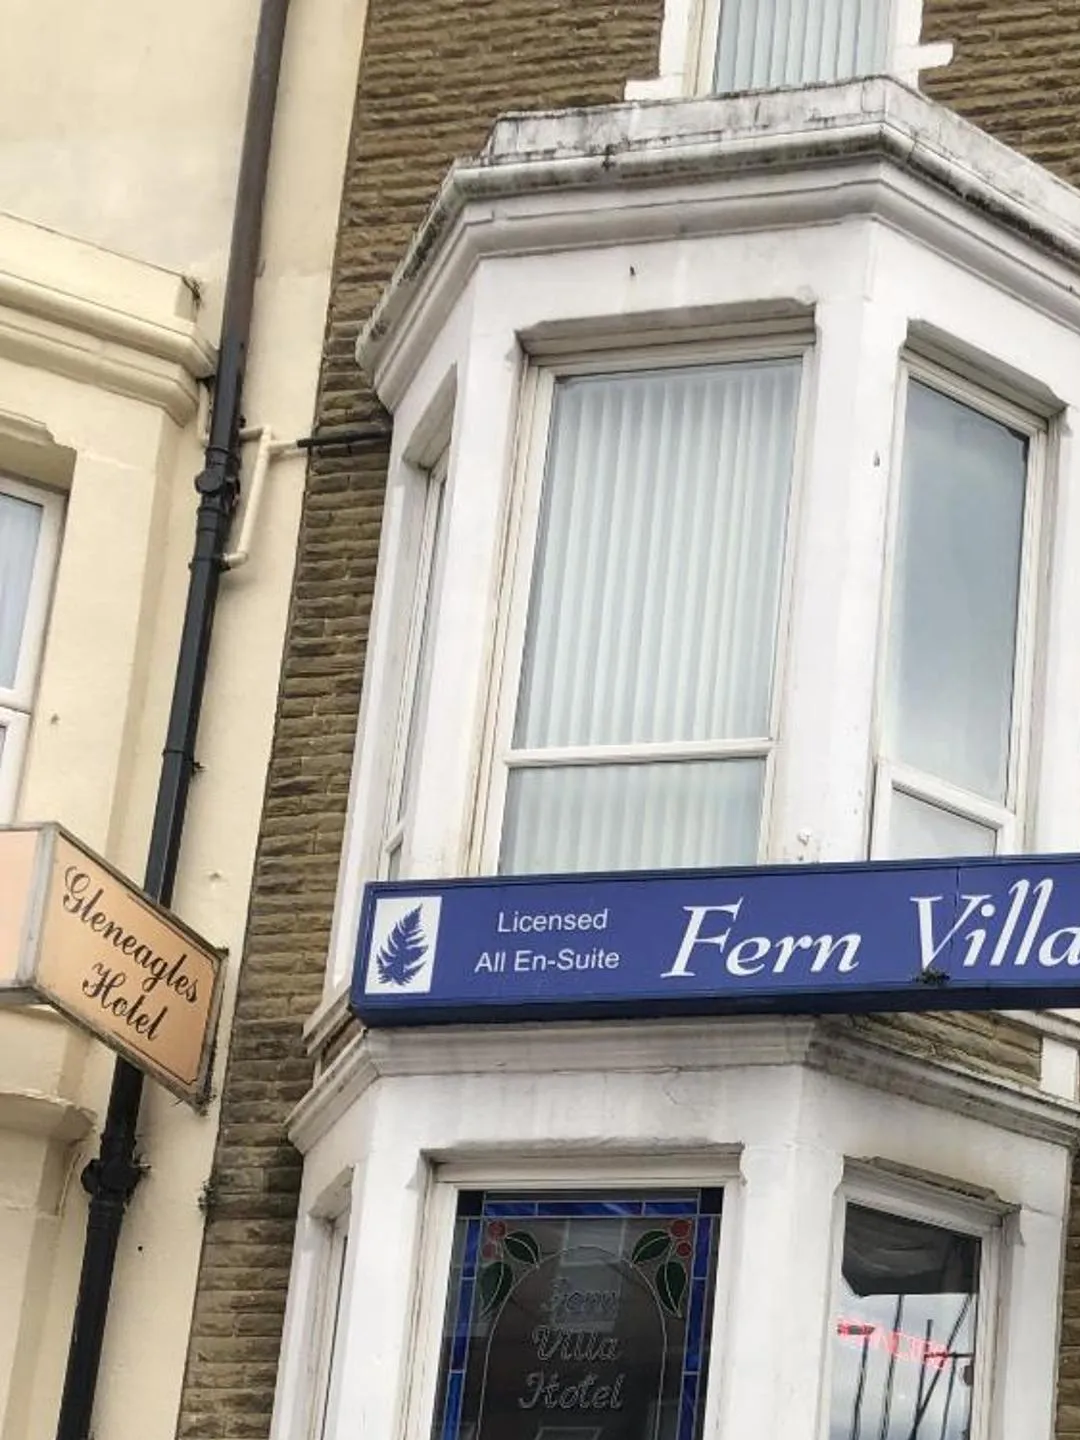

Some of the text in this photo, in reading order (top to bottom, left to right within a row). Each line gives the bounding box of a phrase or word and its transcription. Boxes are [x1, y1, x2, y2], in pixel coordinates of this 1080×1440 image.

[63, 866, 198, 1003] Gleneagles
[498, 910, 608, 934] Licensed
[660, 898, 861, 978] Fern
[475, 947, 620, 974] All En-Suite
[83, 963, 168, 1041] Hotel
[531, 1325, 619, 1360] Villa
[519, 1371, 625, 1409] Hotel
